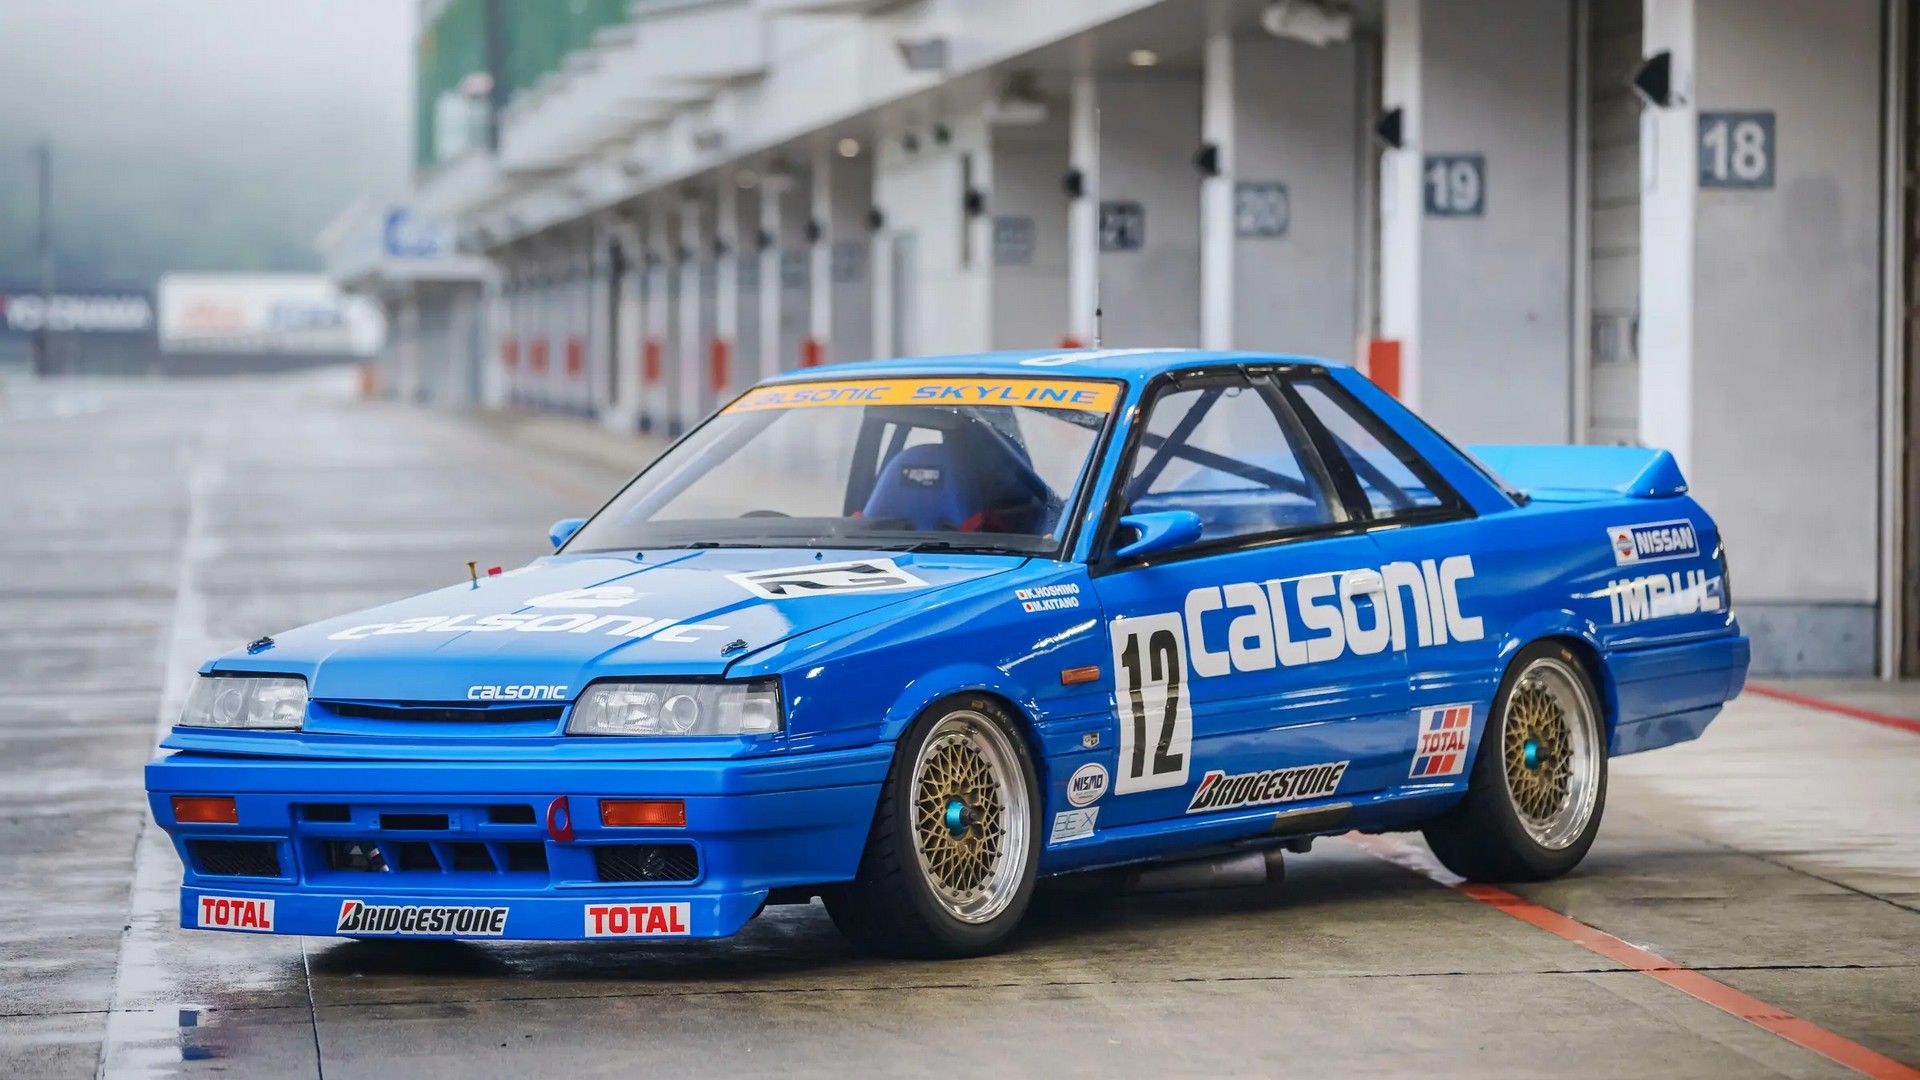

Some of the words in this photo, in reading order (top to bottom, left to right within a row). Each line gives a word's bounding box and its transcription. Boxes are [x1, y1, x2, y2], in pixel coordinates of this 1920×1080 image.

[1703, 121, 1766, 181] 18
[1427, 160, 1480, 210] 19
[912, 385, 1100, 405] SKYLINE
[1635, 527, 1695, 554] NISSAN
[745, 563, 907, 595] 12
[1025, 583, 1080, 598] K.HOSHINO
[1121, 630, 1184, 778] 12
[1421, 729, 1468, 754] TOTAL
[1073, 774, 1104, 792] NISMO
[1188, 763, 1346, 810] BRIDGESTONE
[202, 899, 271, 929] TOTAL
[338, 901, 507, 934] BRIDGESTONE
[588, 906, 686, 934] TOTAL
